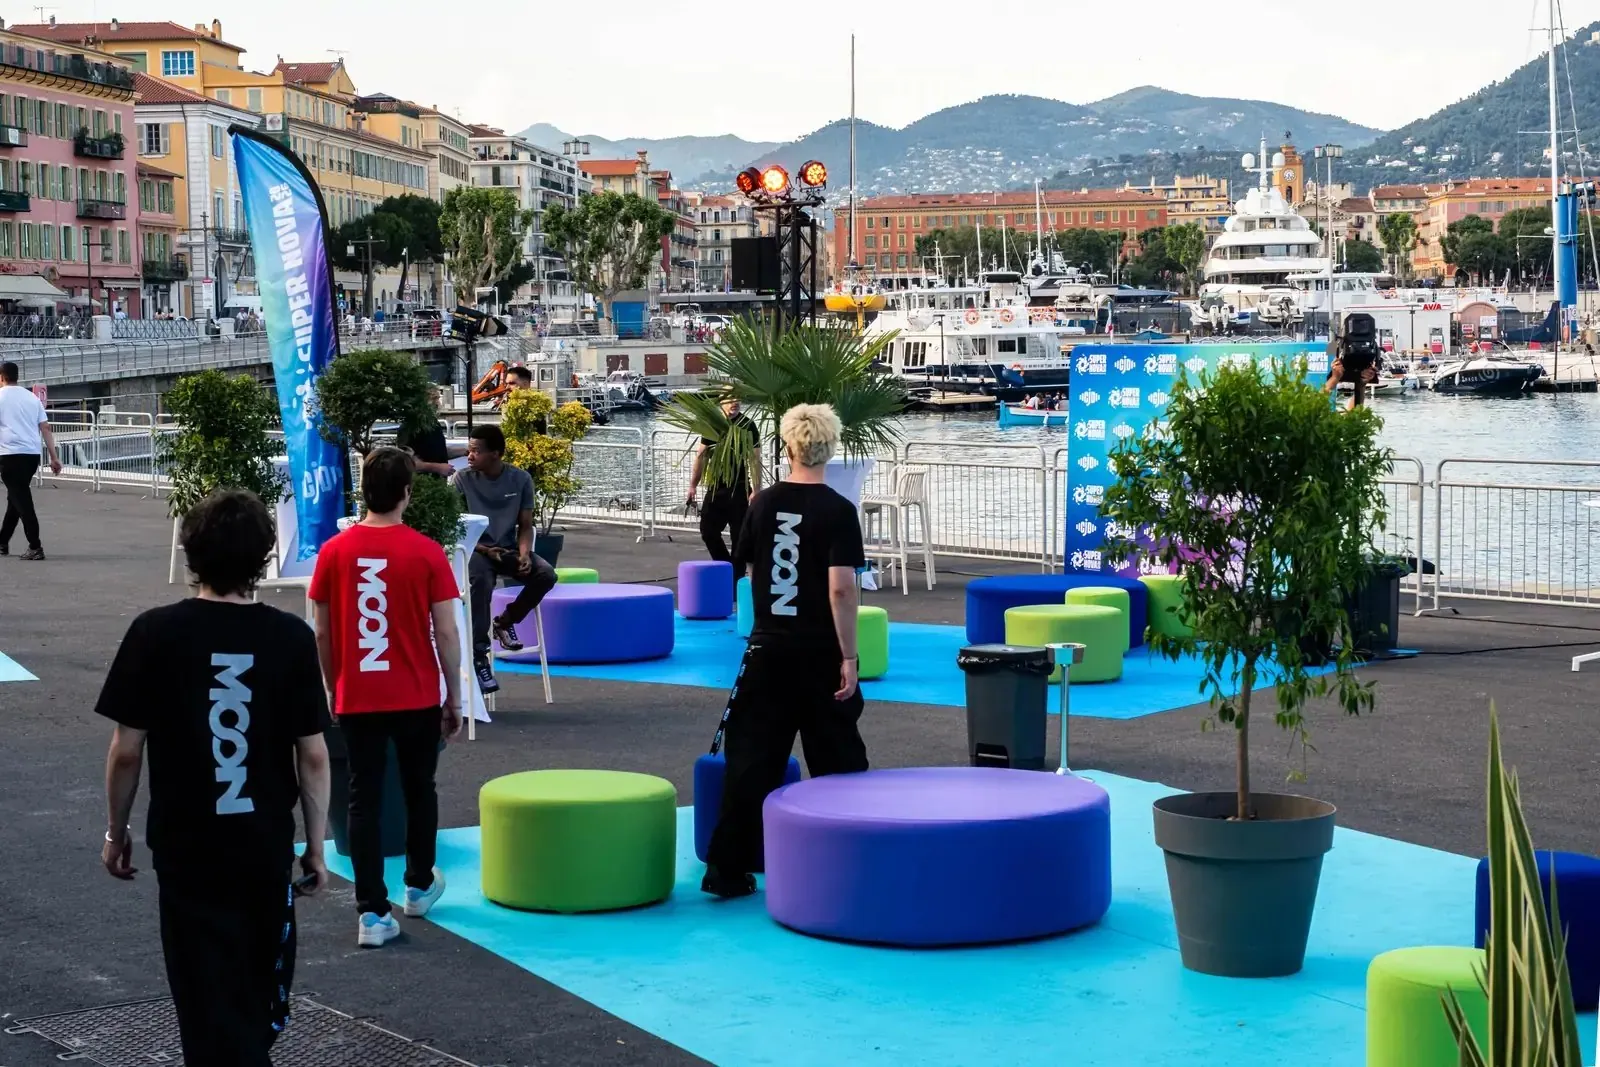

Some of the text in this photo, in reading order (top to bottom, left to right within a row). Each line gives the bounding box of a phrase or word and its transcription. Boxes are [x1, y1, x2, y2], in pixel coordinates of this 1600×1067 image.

[272, 196, 303, 271] NOVA
[1422, 303, 1442, 311] AVIA
[1088, 354, 1107, 364] SUPER
[770, 512, 802, 616] MOON
[1083, 550, 1102, 560] SUPER
[357, 557, 390, 672] MOON
[209, 653, 255, 815] MOON
